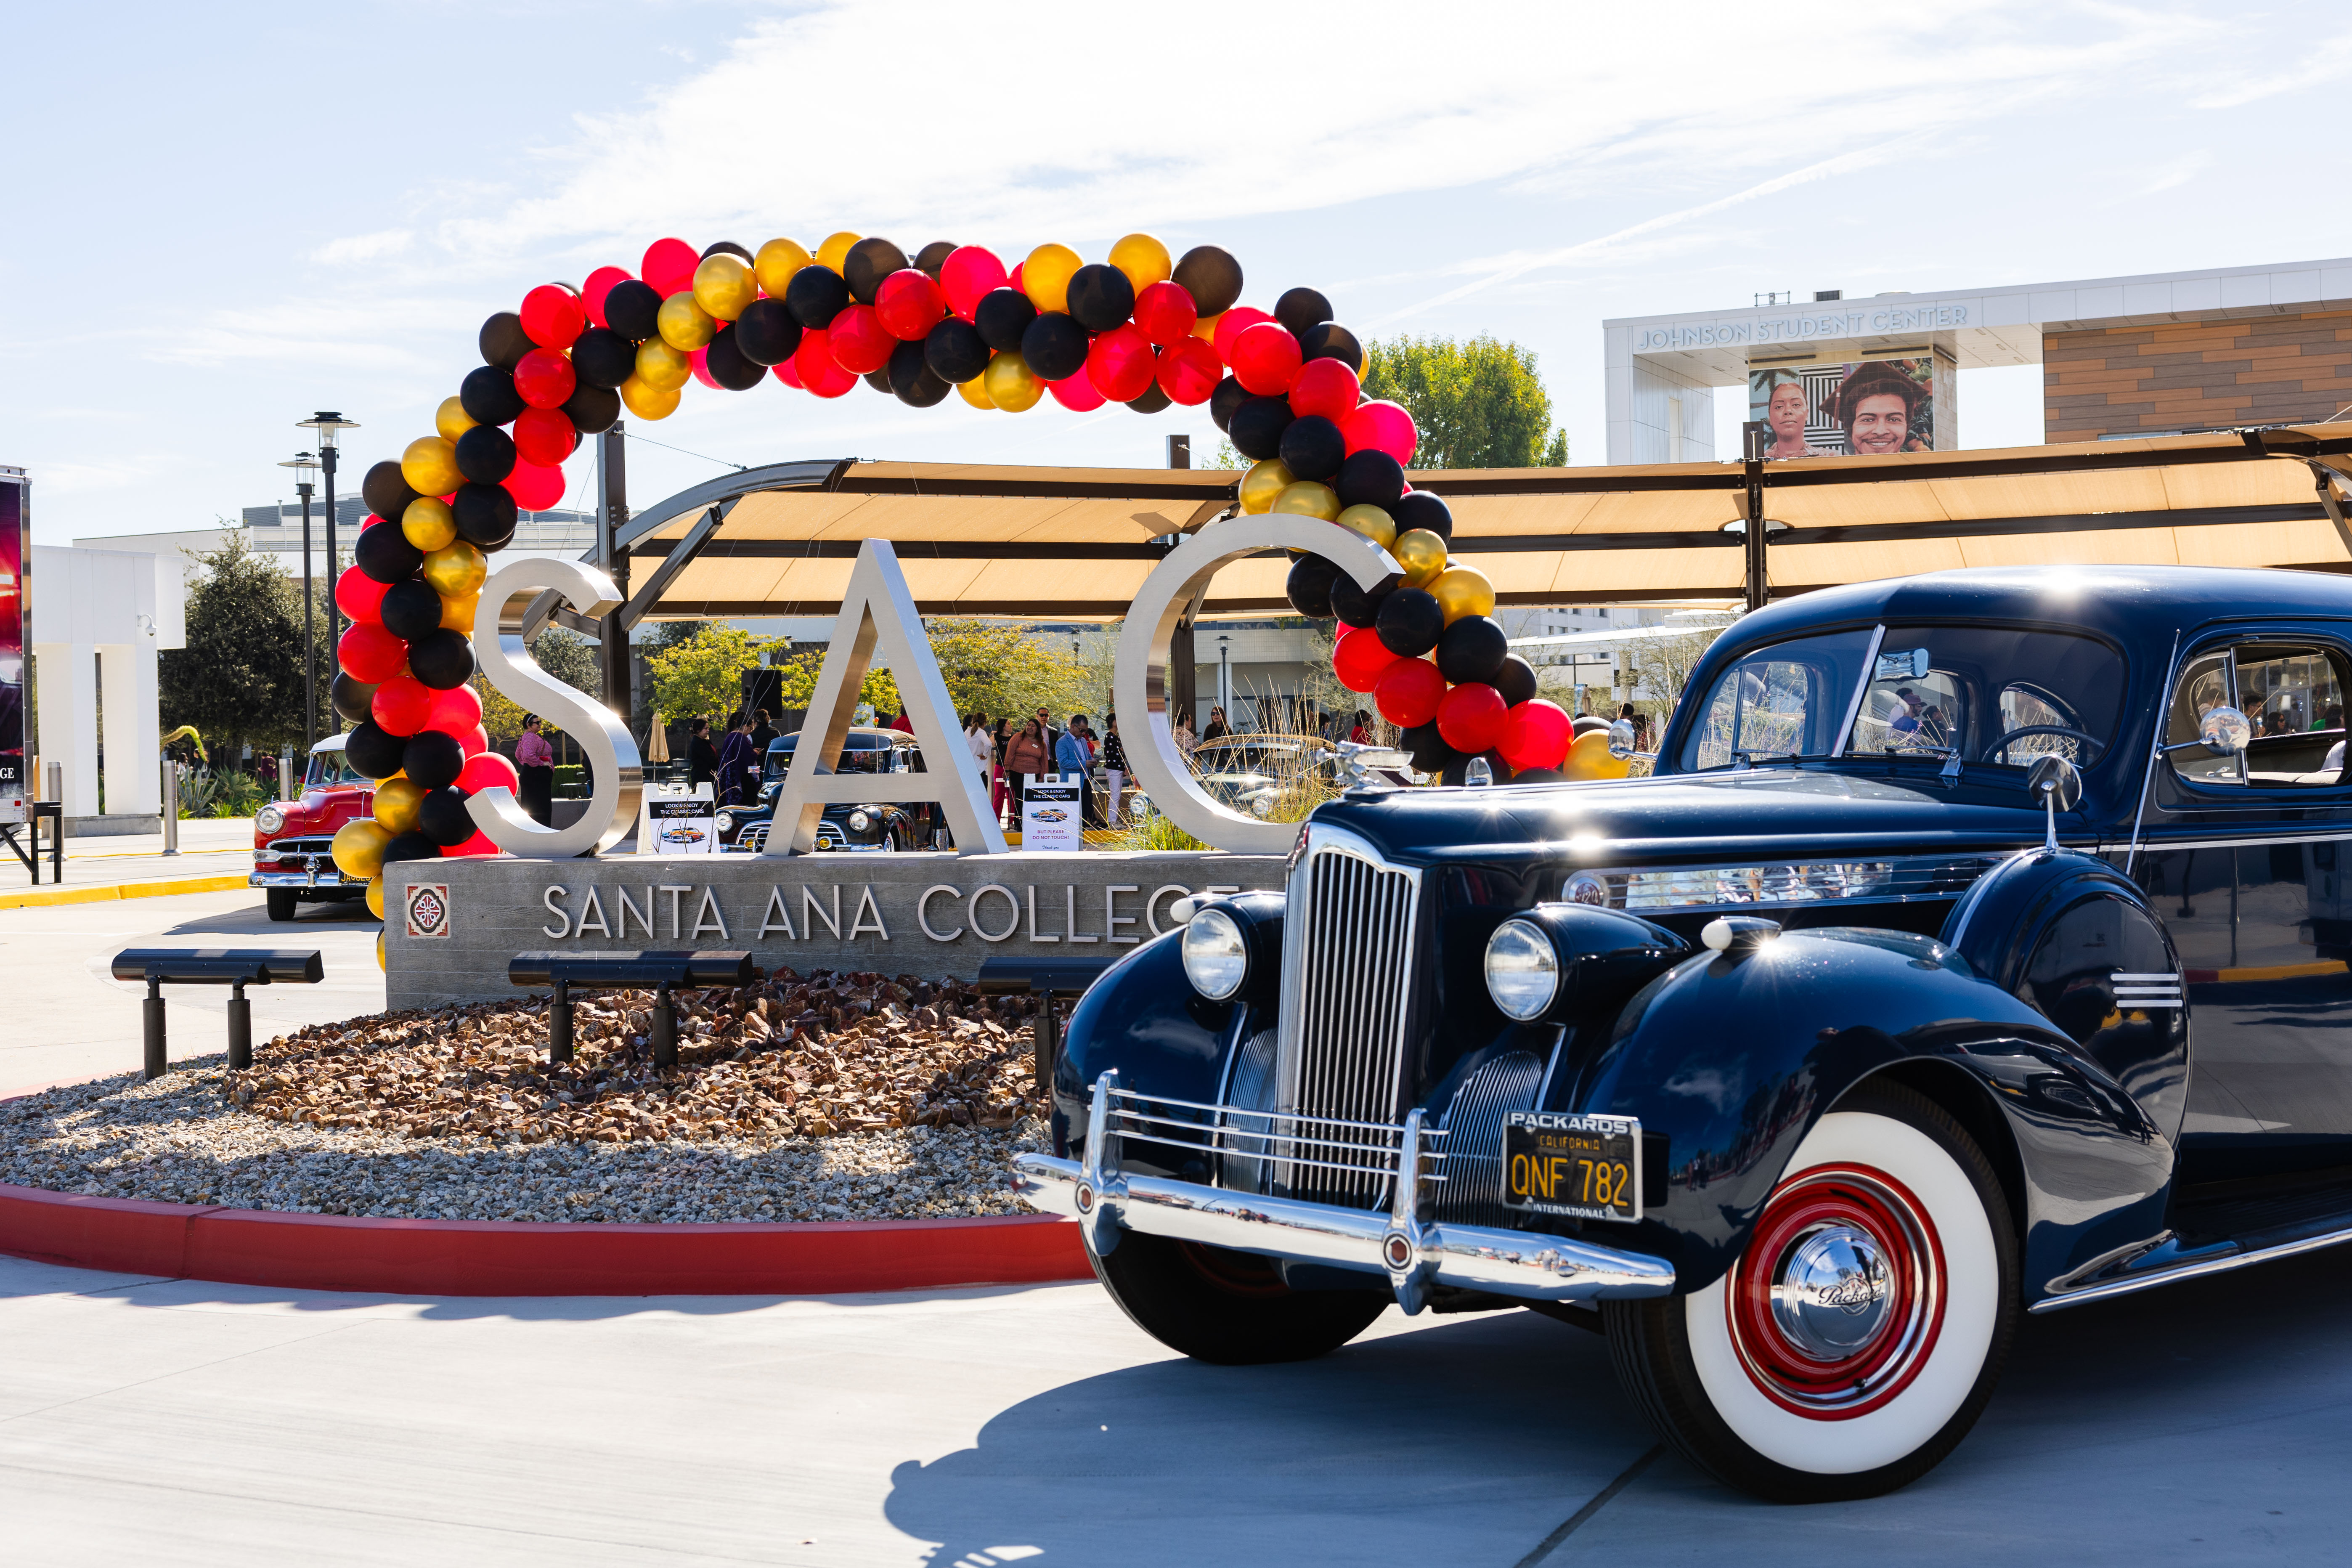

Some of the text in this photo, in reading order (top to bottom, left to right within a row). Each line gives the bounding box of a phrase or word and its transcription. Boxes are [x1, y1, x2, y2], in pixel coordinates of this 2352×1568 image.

[1639, 306, 1967, 349] JOHNSON STUDENT CENTER
[543, 884, 1240, 943] SANTA ANA COLLEG
[1511, 1113, 1628, 1134] PACKARDS
[1539, 1135, 1600, 1151] CALIFORNIA
[1511, 1154, 1628, 1207] QNF 782
[1533, 1203, 1606, 1219] INTERNATIONAL
[1818, 1285, 1884, 1305] Packad
